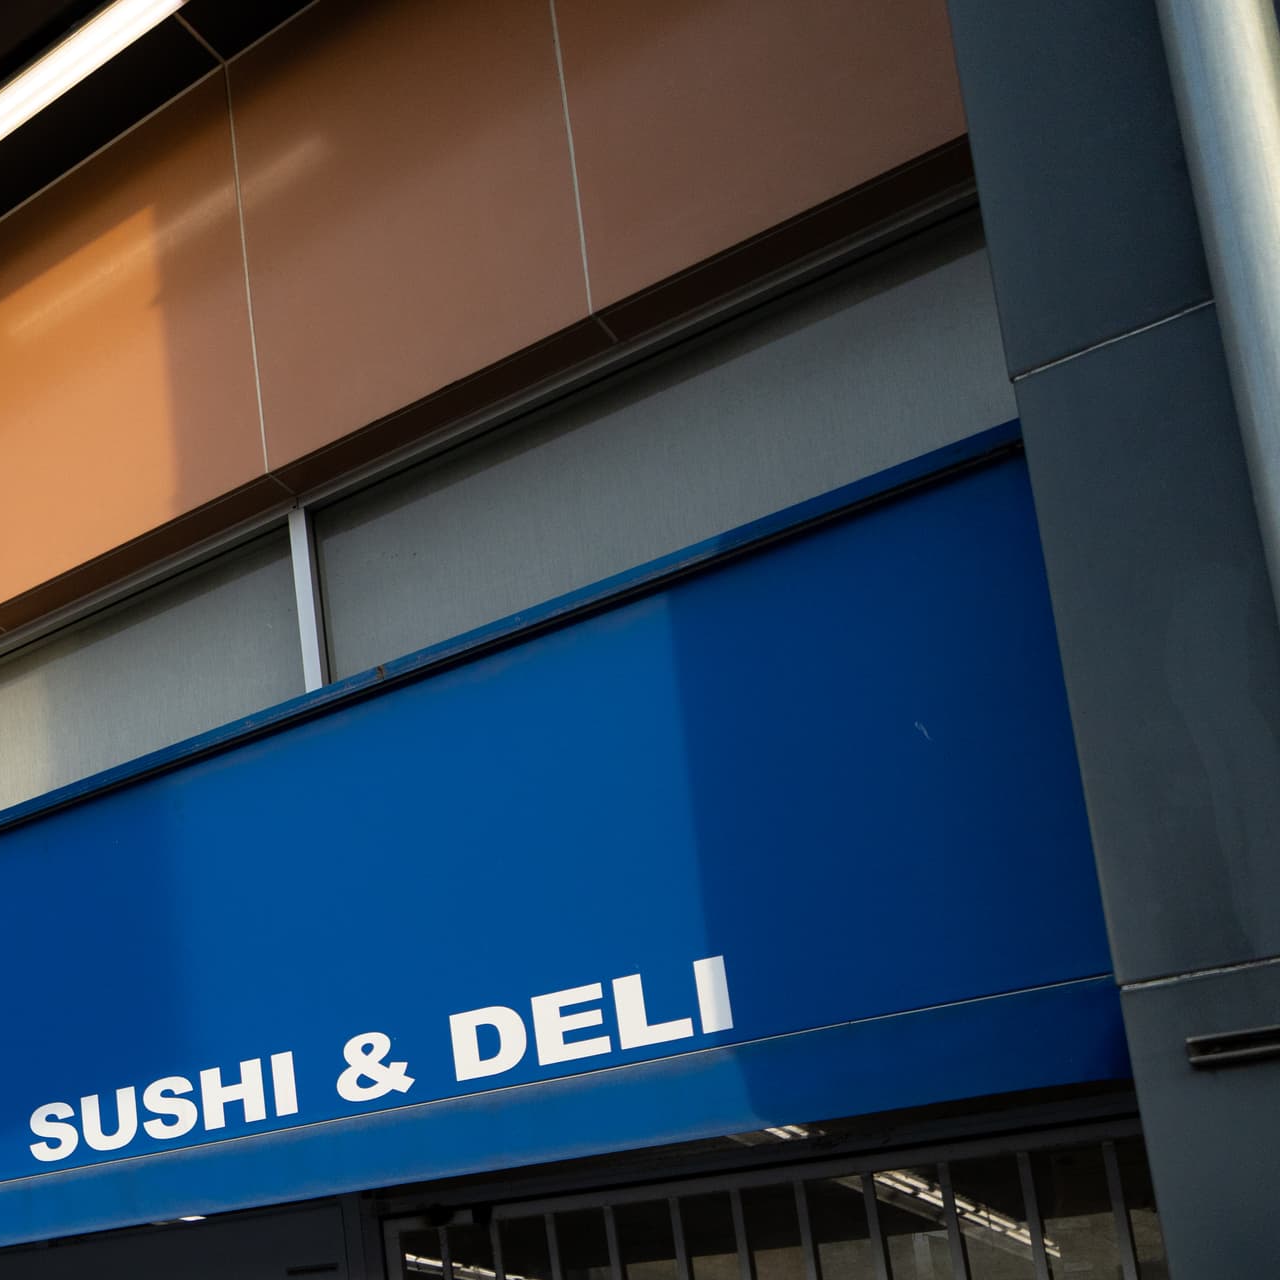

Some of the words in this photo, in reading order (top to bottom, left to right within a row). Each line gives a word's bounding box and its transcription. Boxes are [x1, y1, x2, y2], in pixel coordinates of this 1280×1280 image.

[28, 1050, 300, 1162] SUSHI
[335, 1031, 416, 1103] &
[448, 954, 734, 1082] DELI
